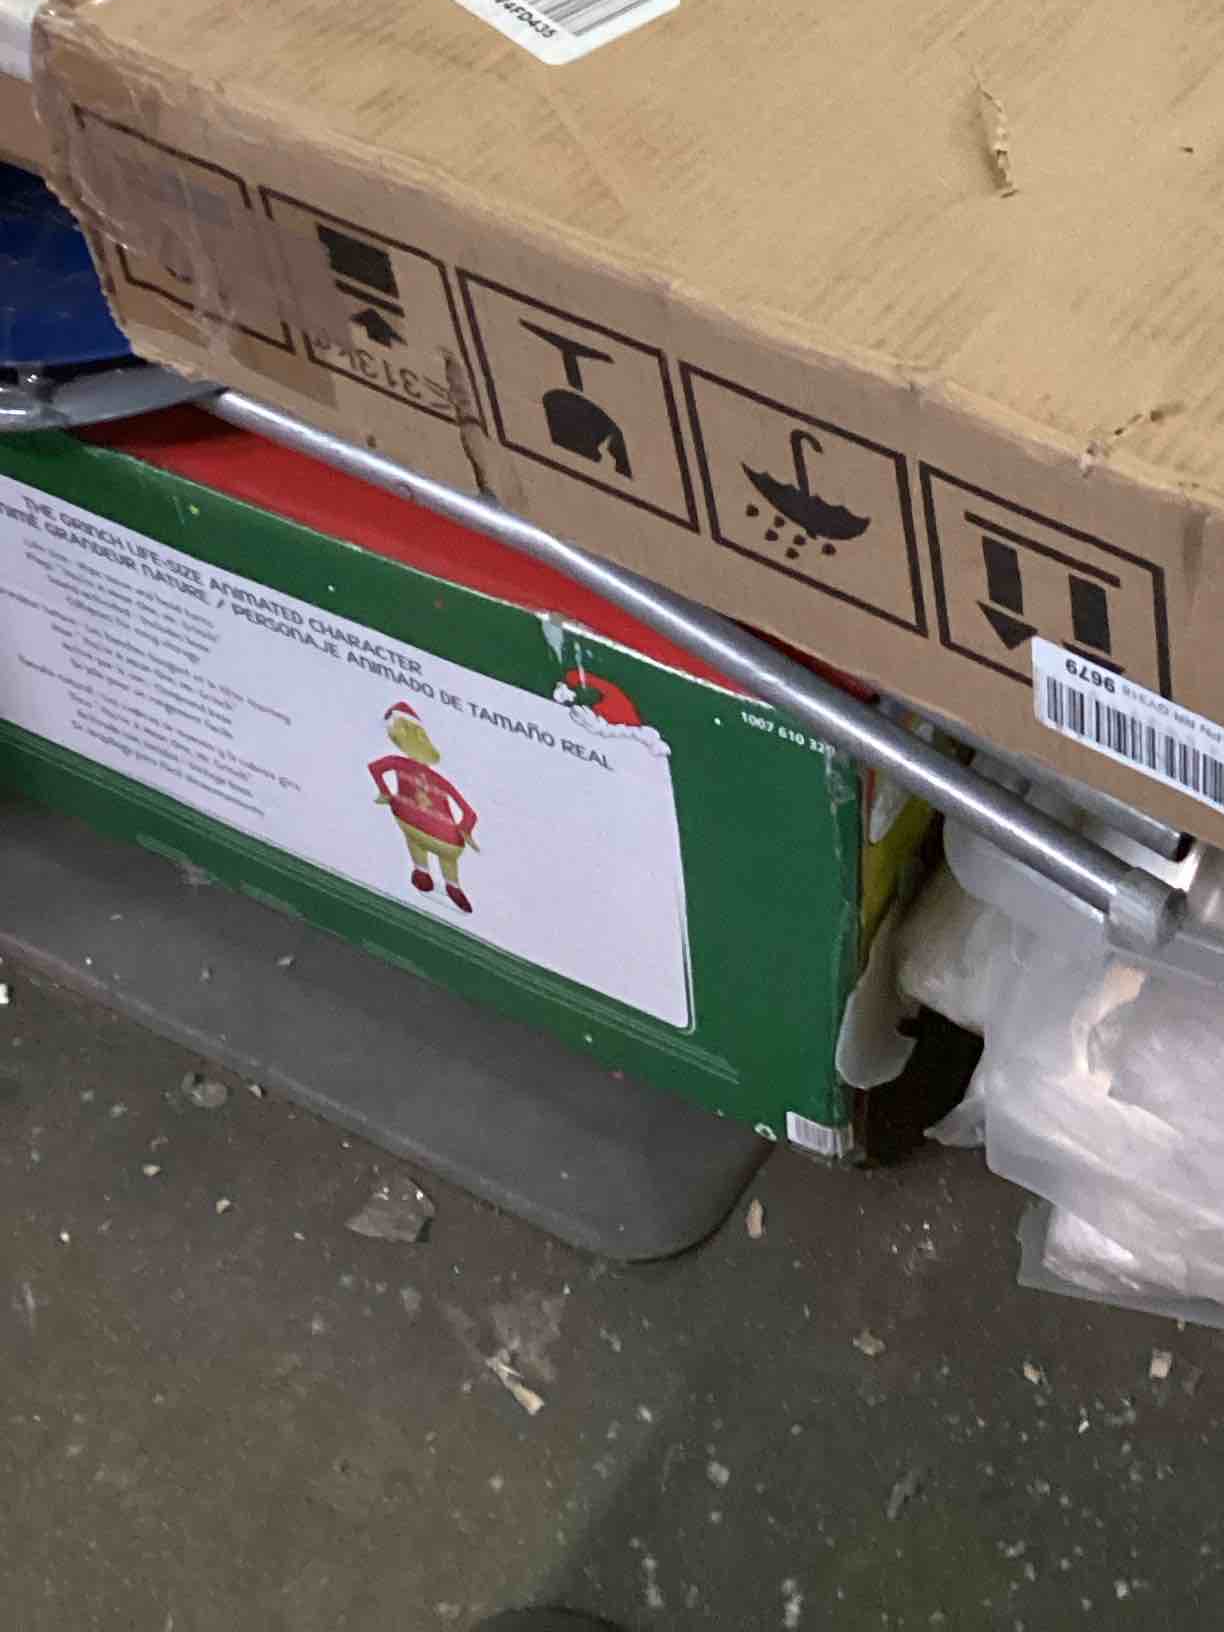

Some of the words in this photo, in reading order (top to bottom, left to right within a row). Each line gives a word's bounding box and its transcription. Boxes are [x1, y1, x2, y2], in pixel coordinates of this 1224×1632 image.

[307, 617, 423, 676] CHARACTER
[1064, 658, 1117, 694] 9679
[440, 689, 465, 710] DE
[561, 739, 612, 770] REAL
[740, 711, 774, 732] 1007
[778, 726, 805, 745] 610
